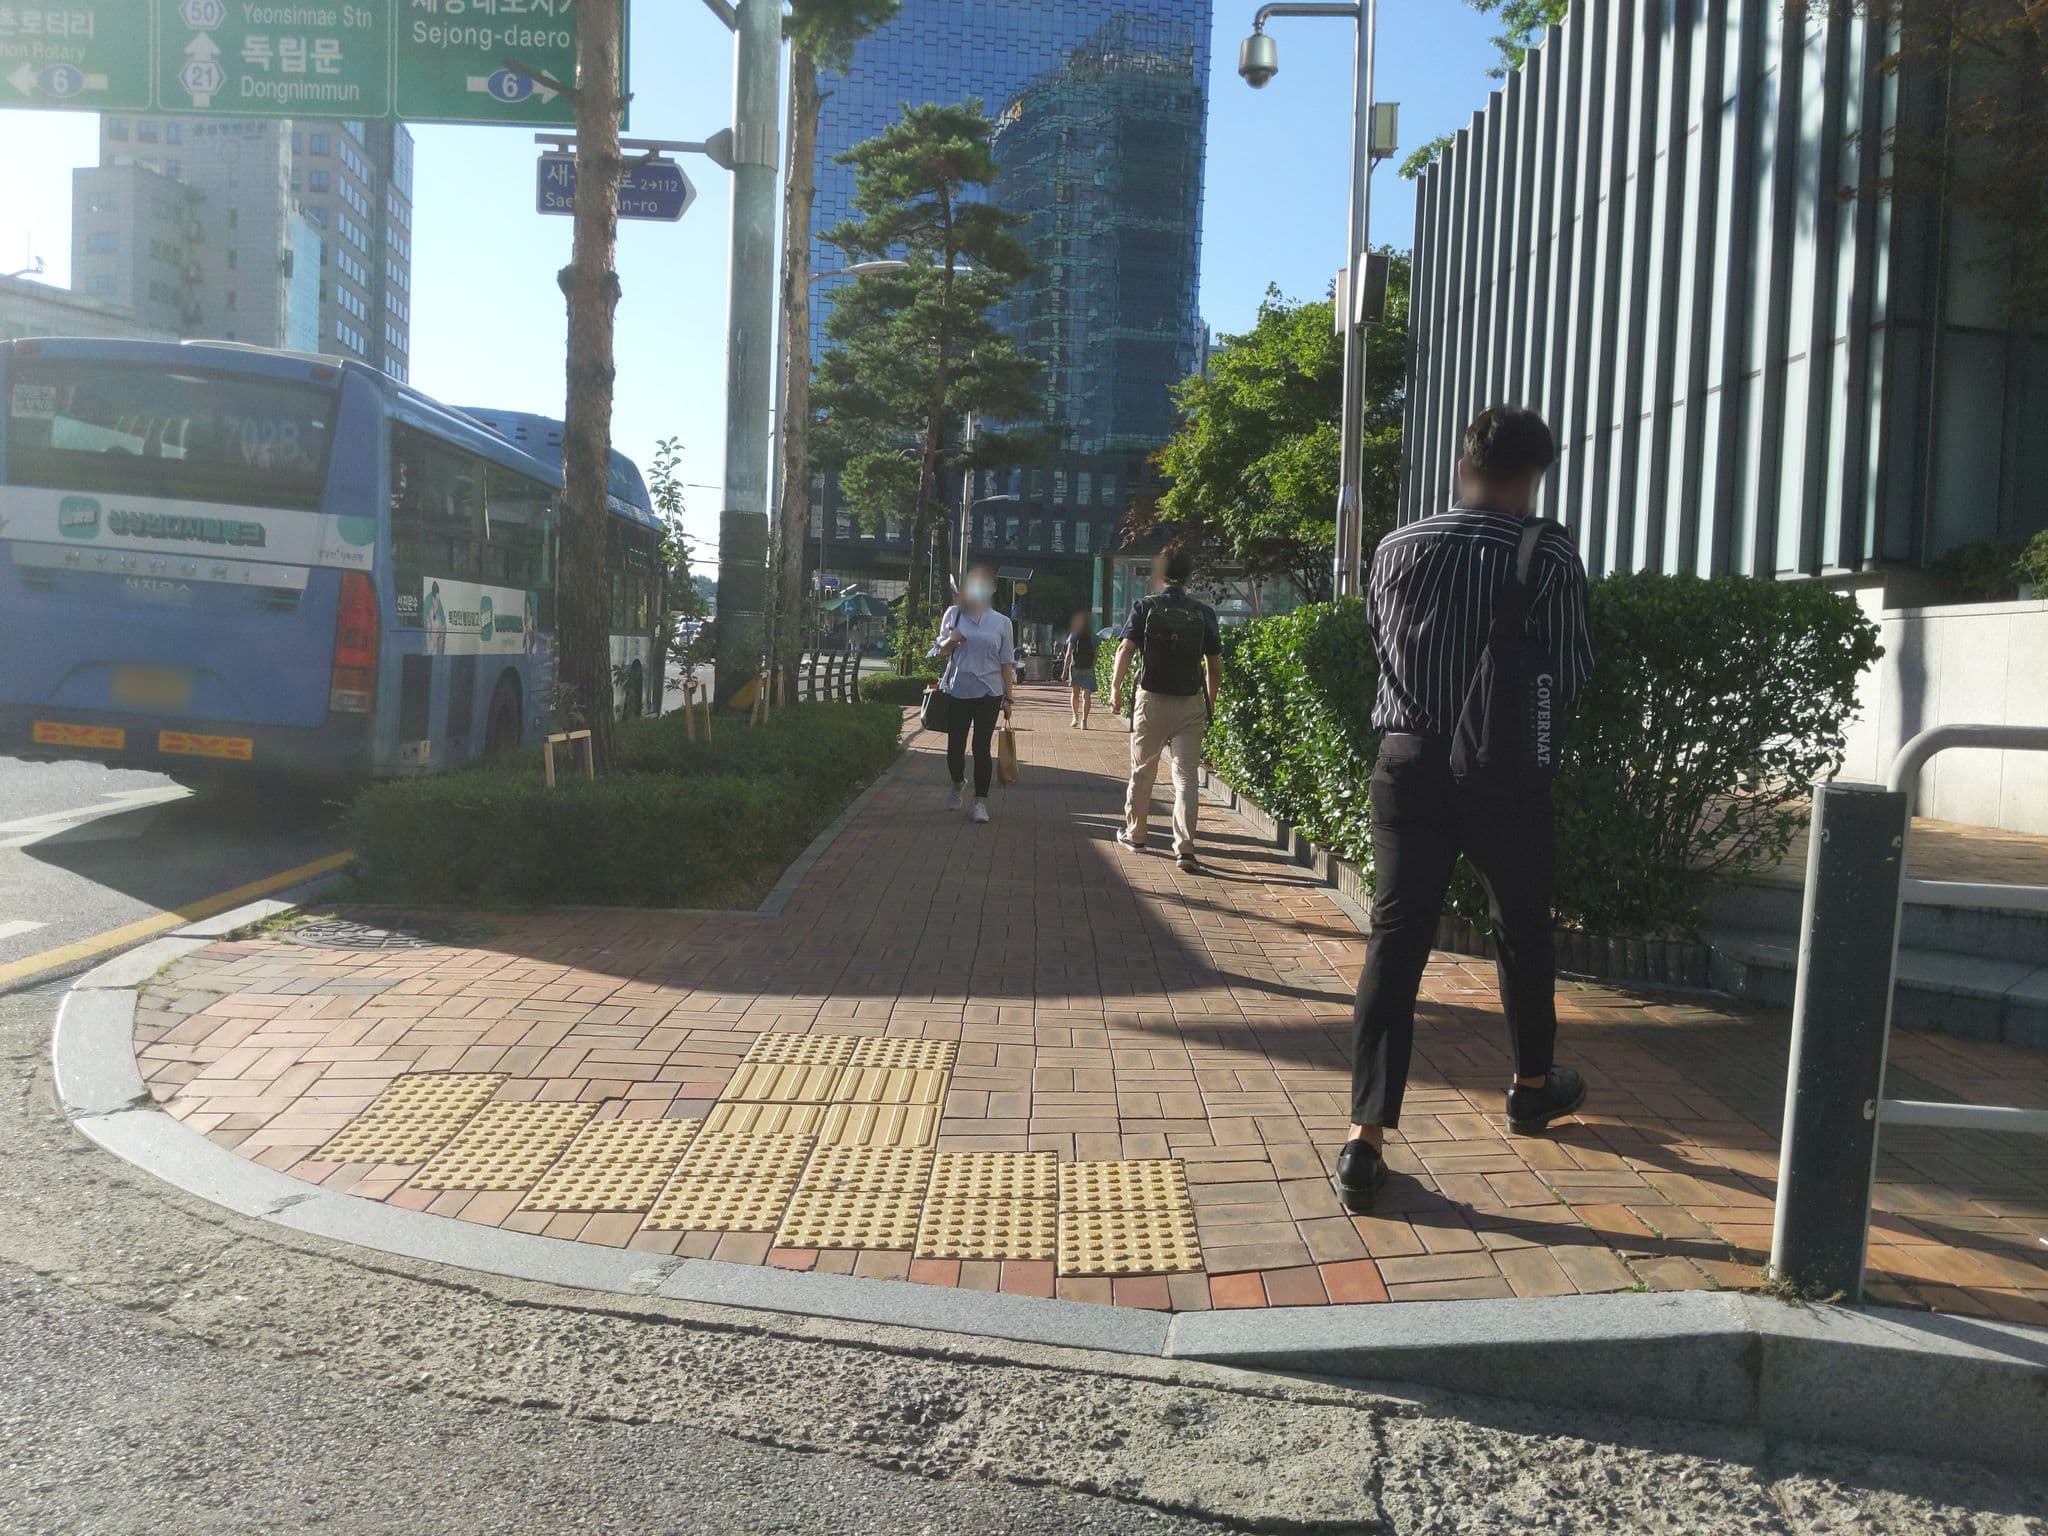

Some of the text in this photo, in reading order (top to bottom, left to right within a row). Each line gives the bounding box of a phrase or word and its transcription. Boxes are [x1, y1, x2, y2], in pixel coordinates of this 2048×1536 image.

[191, 1, 214, 22] 50
[243, 3, 372, 28] Yeonsinnae Stn
[412, 20, 570, 50] Sejong-daero
[32, 41, 86, 64] Rotary
[241, 35, 343, 74] 독립문
[53, 69, 69, 93] 6
[192, 66, 214, 89] 21
[241, 75, 360, 104] Dongnimmun
[502, 73, 518, 97] 6
